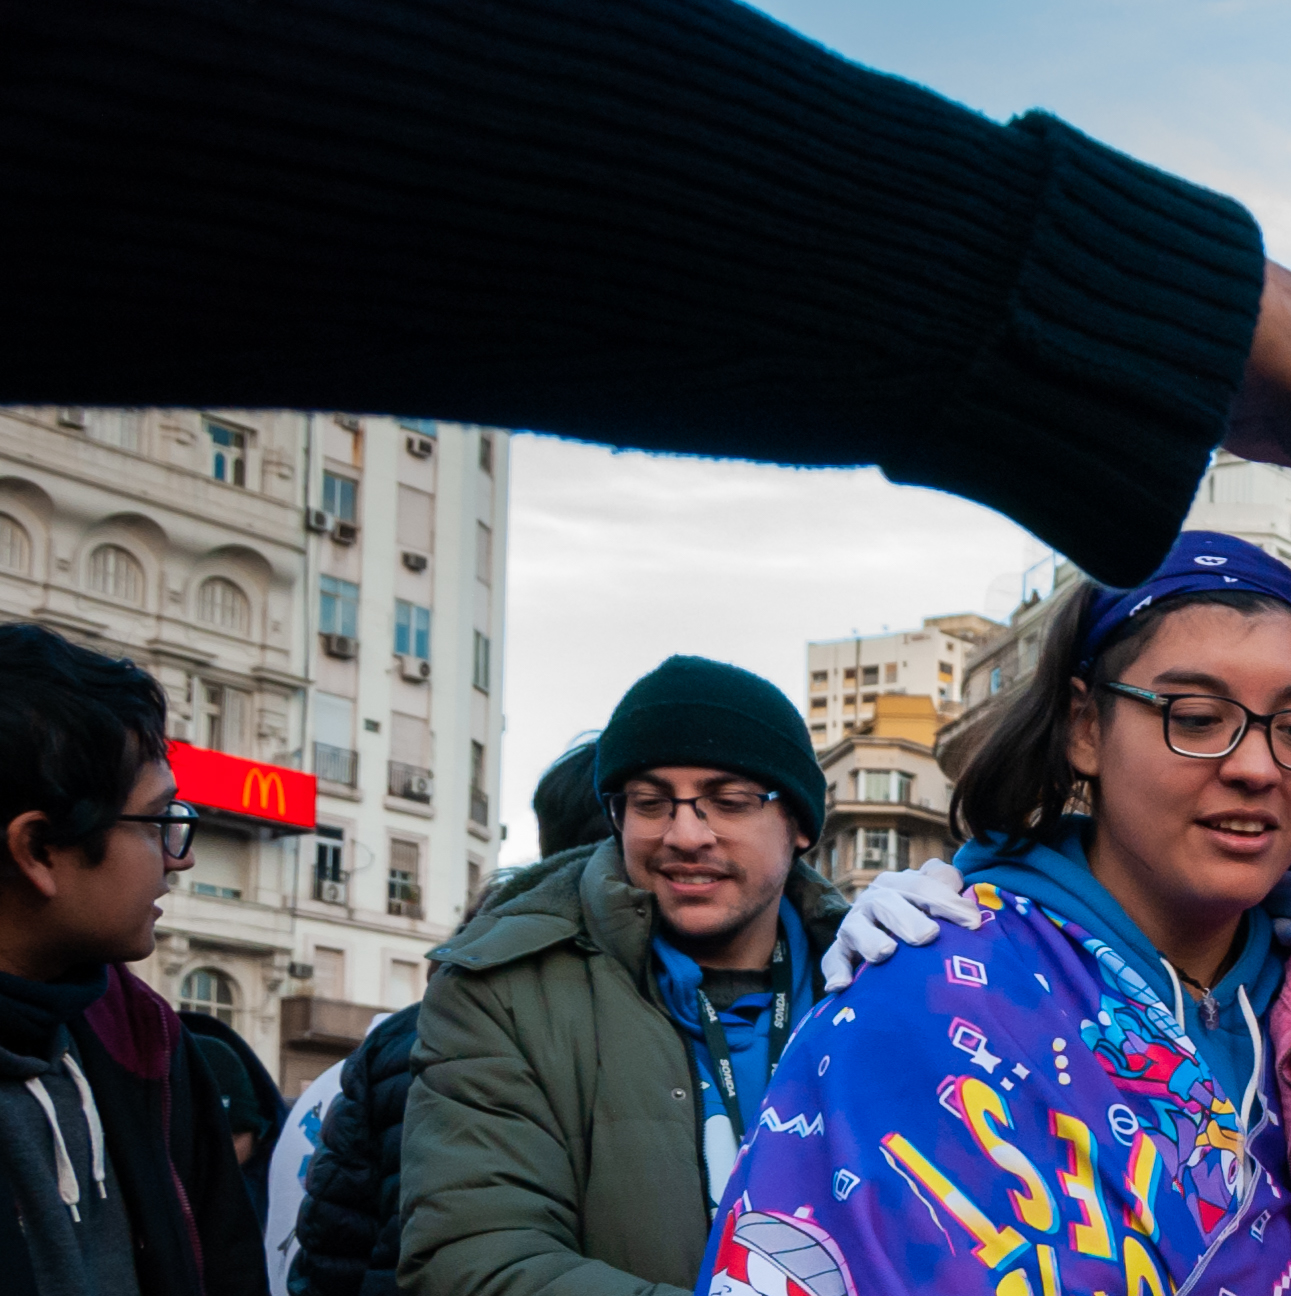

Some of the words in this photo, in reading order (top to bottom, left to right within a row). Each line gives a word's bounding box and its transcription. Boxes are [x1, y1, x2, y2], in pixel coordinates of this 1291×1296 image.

[774, 993, 786, 1029] SONDA
[720, 1058, 736, 1098] SONDA
[880, 1075, 1162, 1271] FEST
